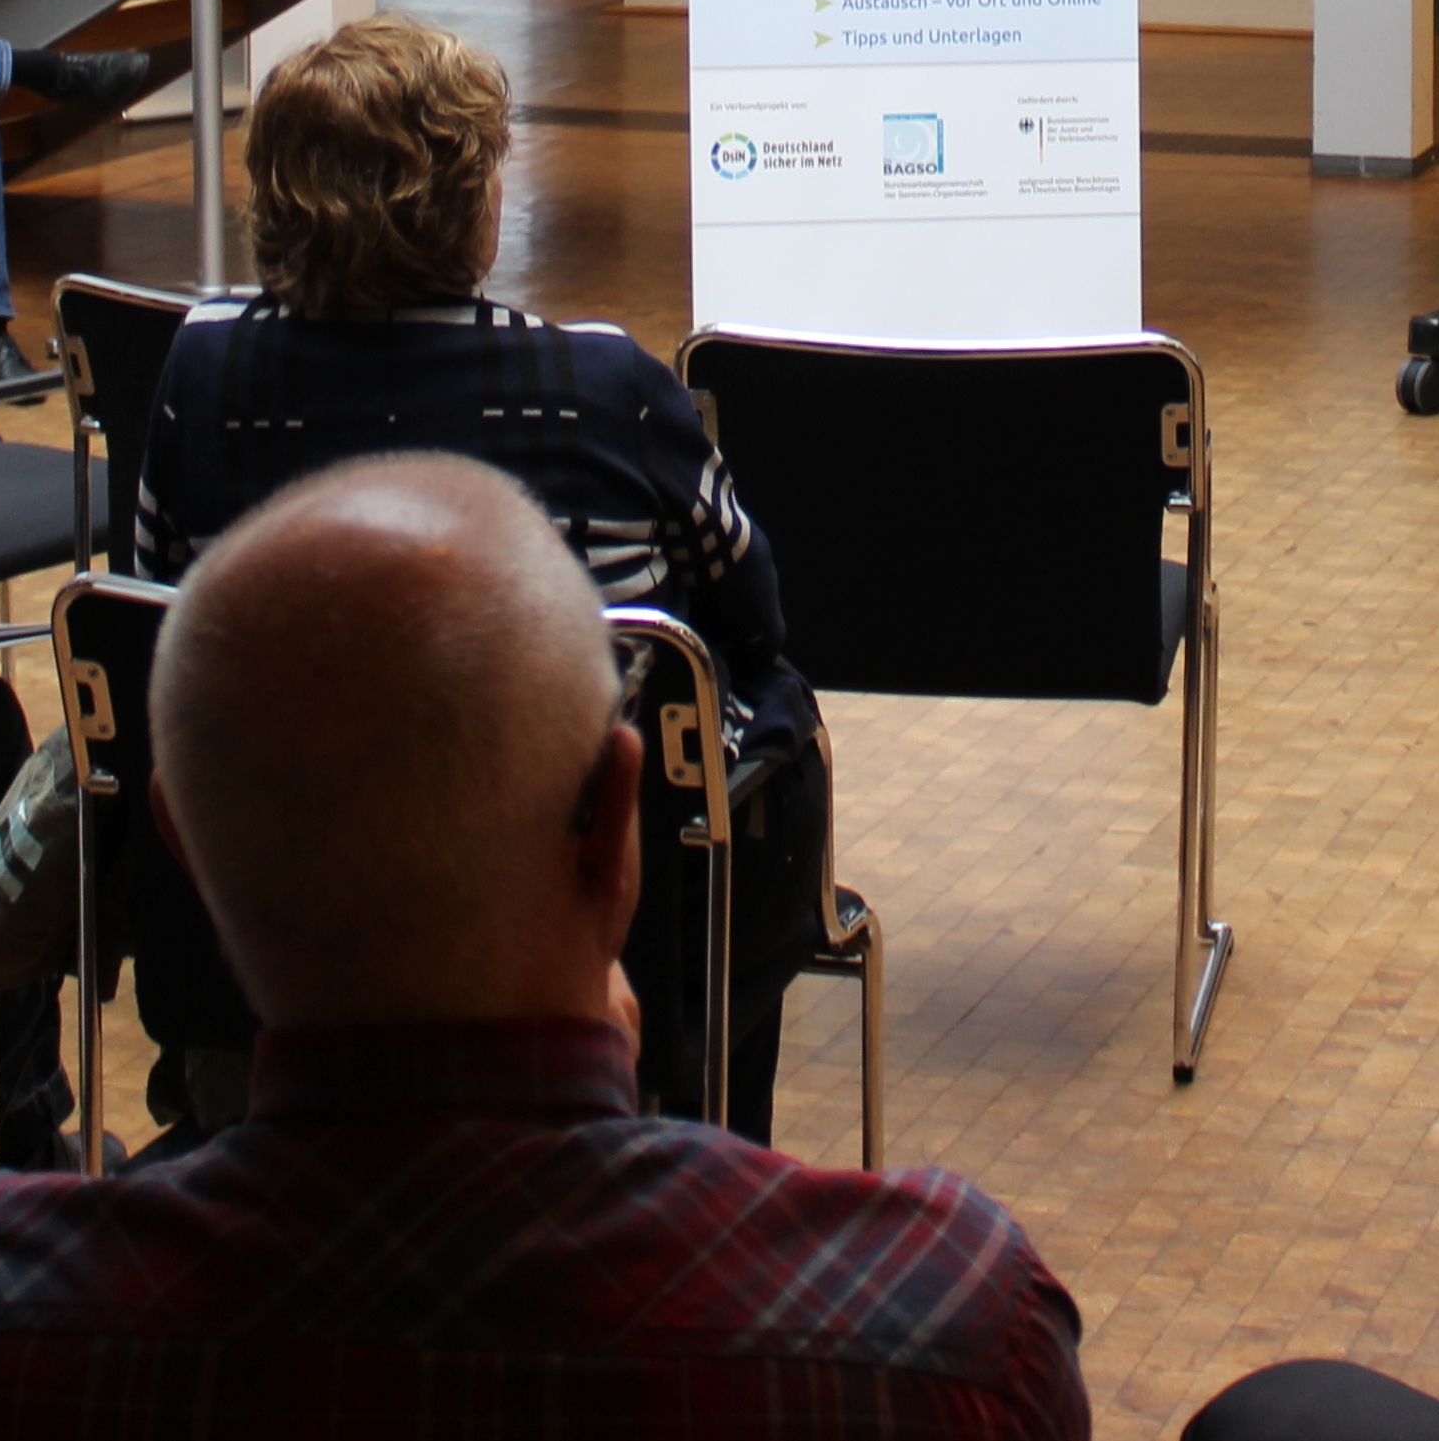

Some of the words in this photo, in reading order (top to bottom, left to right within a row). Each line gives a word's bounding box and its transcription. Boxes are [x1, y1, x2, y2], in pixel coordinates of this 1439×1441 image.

[842, 30, 887, 49] Tipps
[893, 29, 924, 46] und
[929, 28, 1022, 47] Unterlagen
[710, 102, 723, 111] Ein
[763, 140, 833, 154] Deutschland
[723, 150, 745, 163] DsiN
[763, 157, 796, 169] sicher
[801, 156, 814, 168] im
[818, 154, 842, 167] Netz
[883, 163, 937, 175] BAGSO
